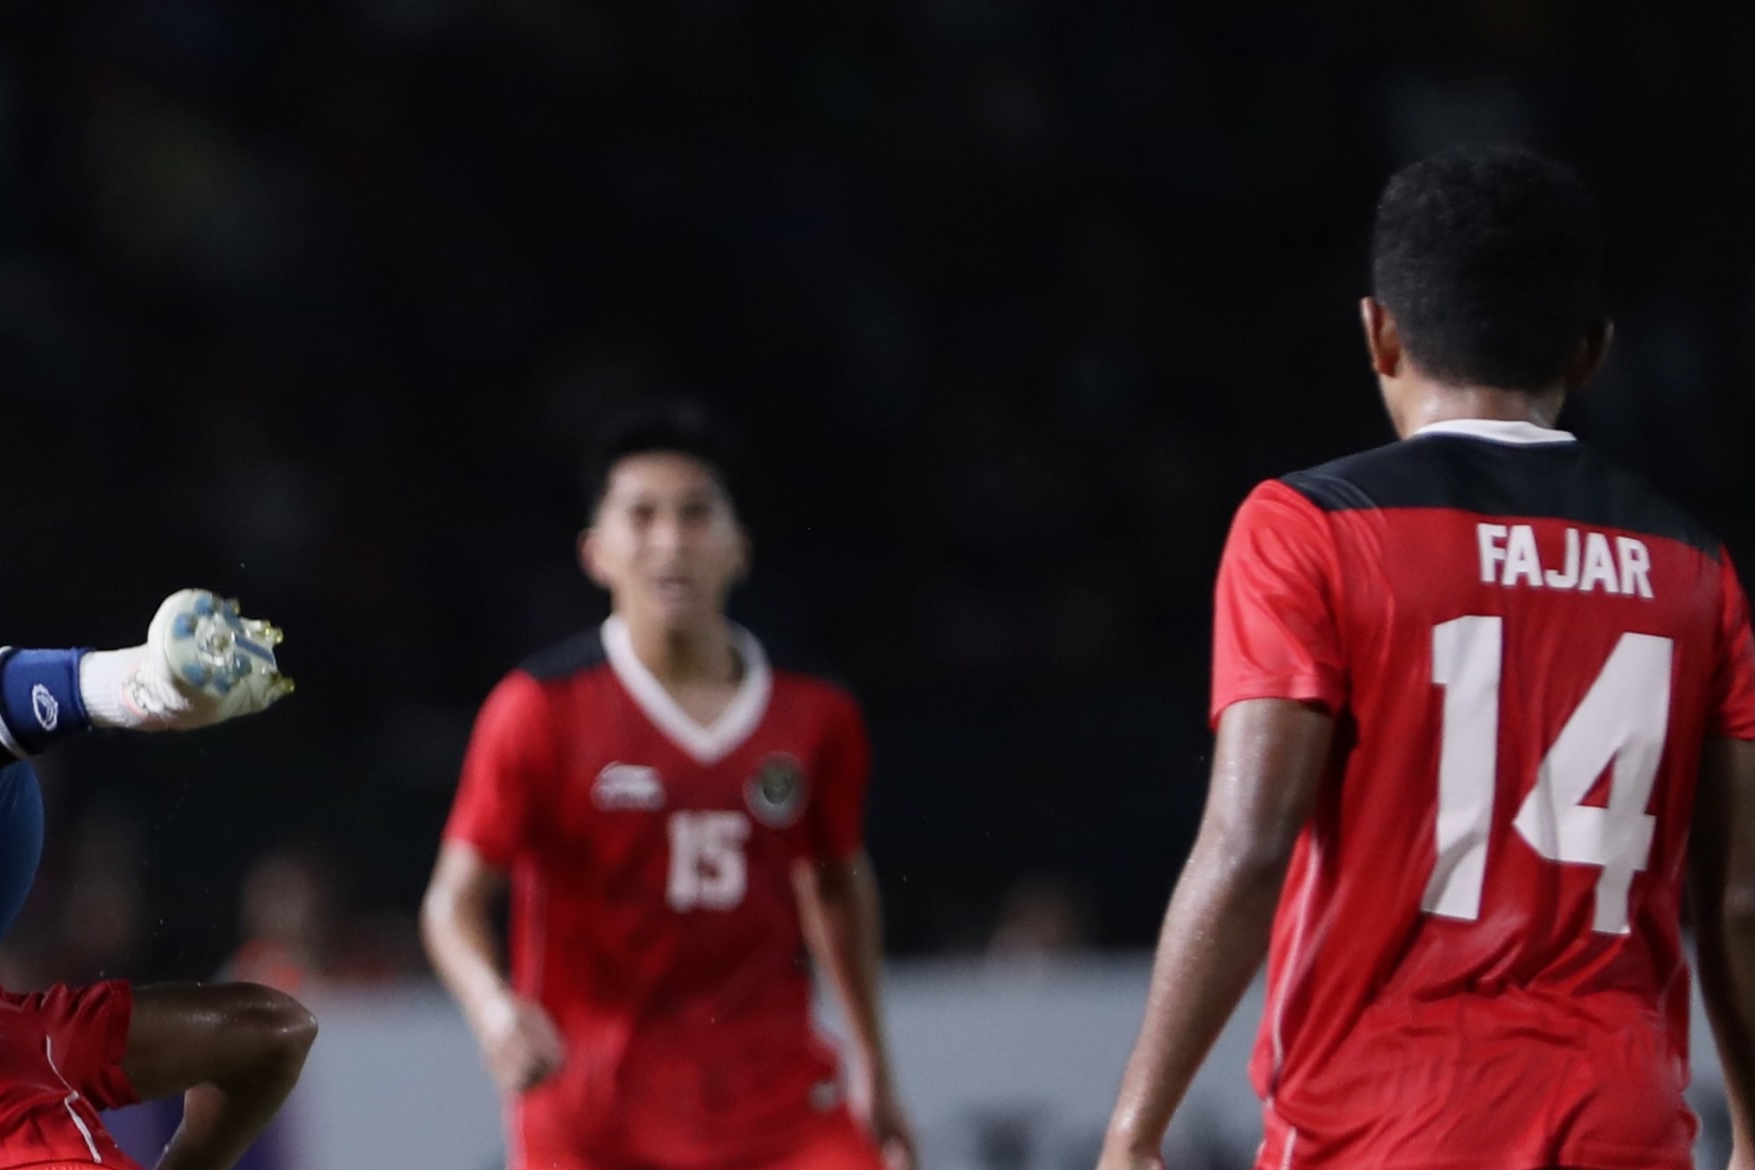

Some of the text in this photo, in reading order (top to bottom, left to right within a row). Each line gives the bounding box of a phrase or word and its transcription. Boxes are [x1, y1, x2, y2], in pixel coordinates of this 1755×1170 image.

[1477, 521, 1655, 598] FAJAR
[1420, 614, 1674, 936] 14
[666, 809, 753, 912] 15
